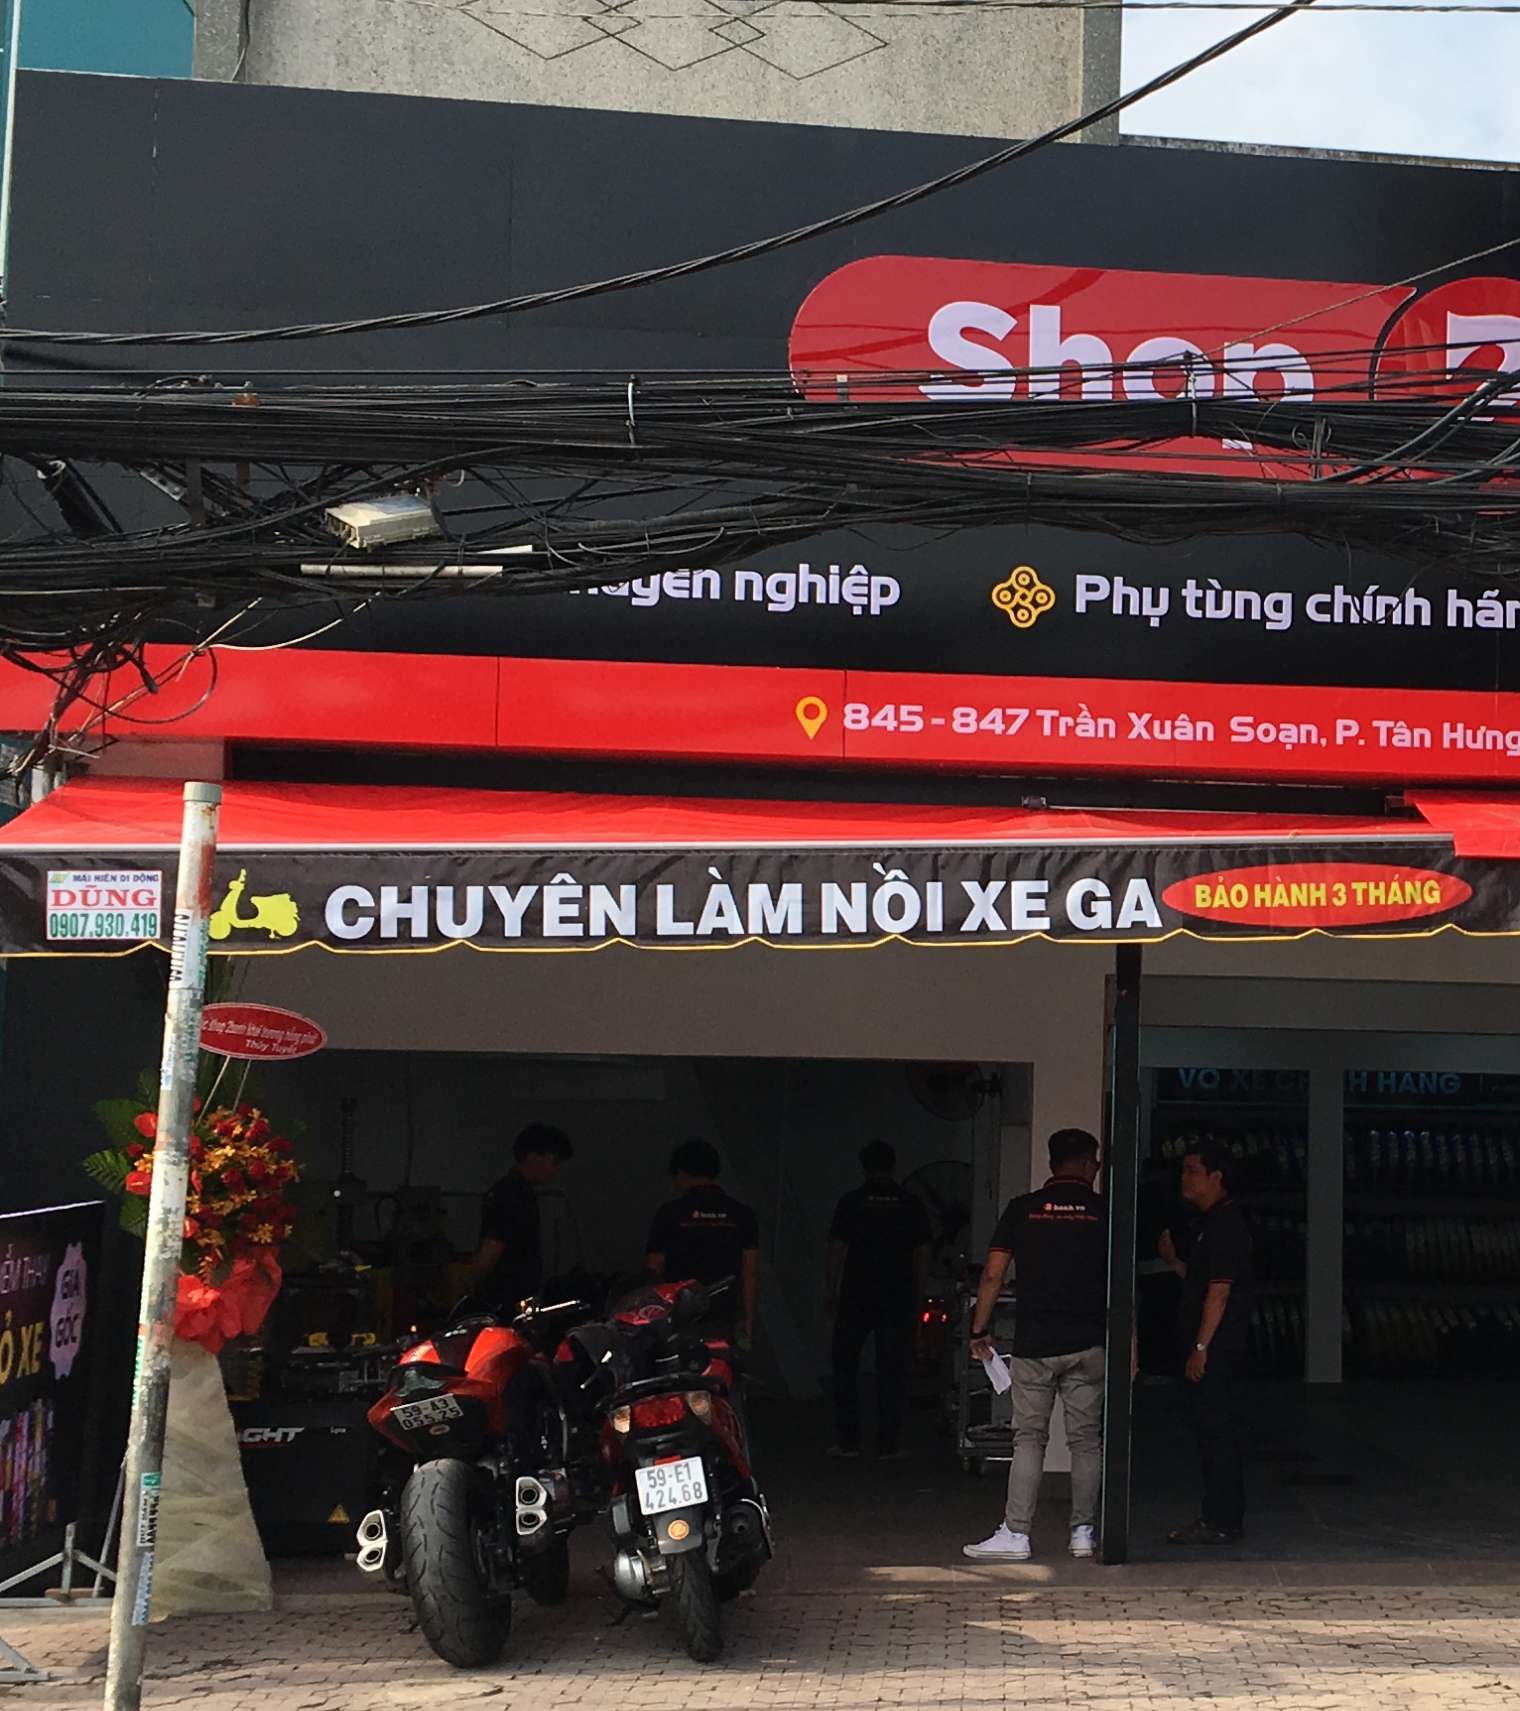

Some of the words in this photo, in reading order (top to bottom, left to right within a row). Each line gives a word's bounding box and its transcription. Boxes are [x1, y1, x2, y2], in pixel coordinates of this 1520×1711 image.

[919, 301, 1314, 449] Shop
[735, 564, 900, 615] nghiệp
[1076, 574, 1170, 628] Phụ
[1182, 577, 1293, 630] tùng
[1306, 585, 1431, 626] chính
[844, 703, 923, 733] 845
[1036, 703, 1116, 738] Trần
[1128, 711, 1214, 742] Xuân
[1230, 715, 1327, 751] Soạn,
[1336, 718, 1365, 747] P.
[1373, 720, 1431, 750] Tân
[51, 884, 157, 907] DŨNG
[324, 873, 637, 939] CHUYÊN
[657, 866, 803, 937] LÀM
[821, 862, 943, 936] NỒI
[960, 879, 1051, 932] XE
[1066, 878, 1165, 930] GA
[1195, 876, 1250, 909] BẢO
[1254, 875, 1327, 907] HÀNH
[1332, 883, 1347, 906] 3
[1350, 872, 1441, 905] THÁNG
[50, 913, 158, 938] 0907.930.419
[645, 1481, 703, 1511] 424.68
